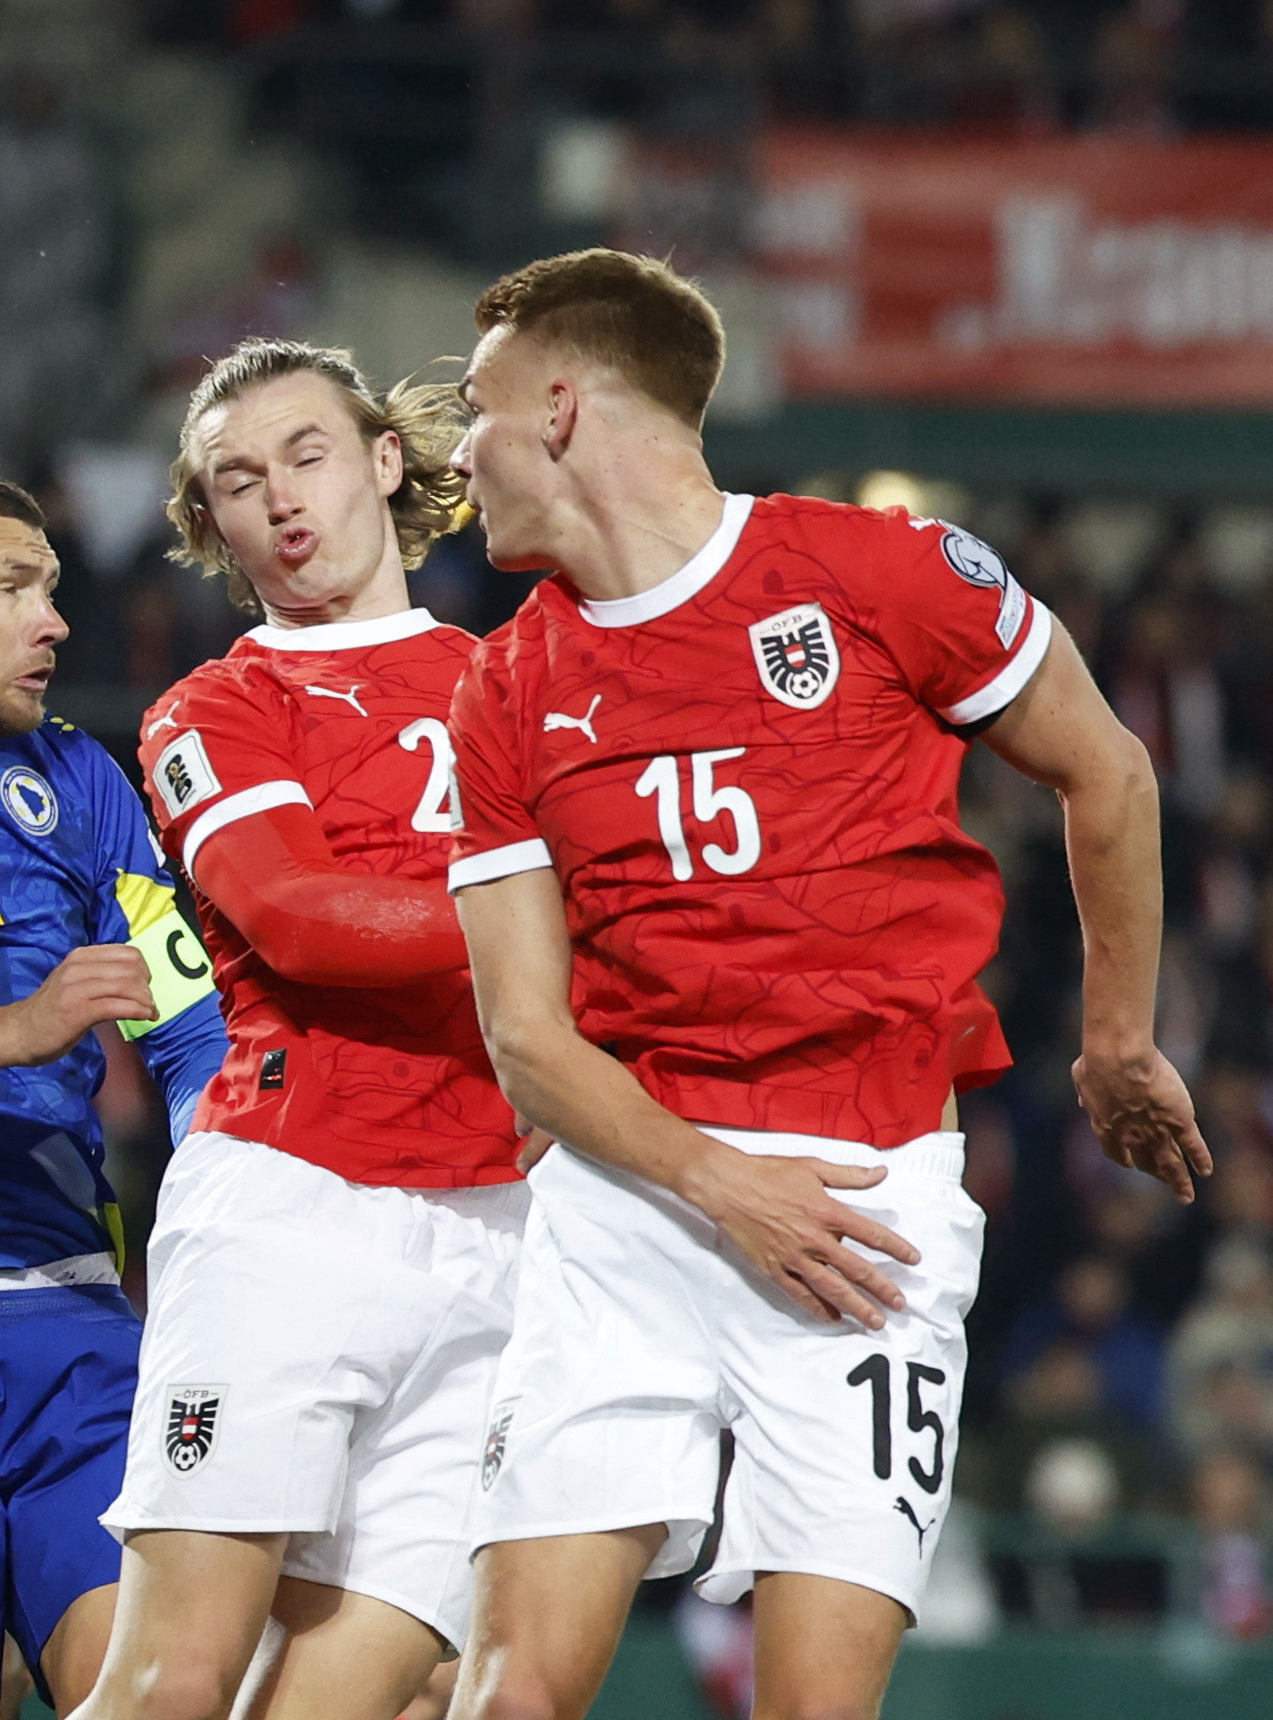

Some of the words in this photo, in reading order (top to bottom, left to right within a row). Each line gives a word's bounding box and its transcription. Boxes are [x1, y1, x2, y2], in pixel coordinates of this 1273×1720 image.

[635, 746, 762, 882] 15
[166, 929, 209, 980] C
[846, 1353, 946, 1495] 15
